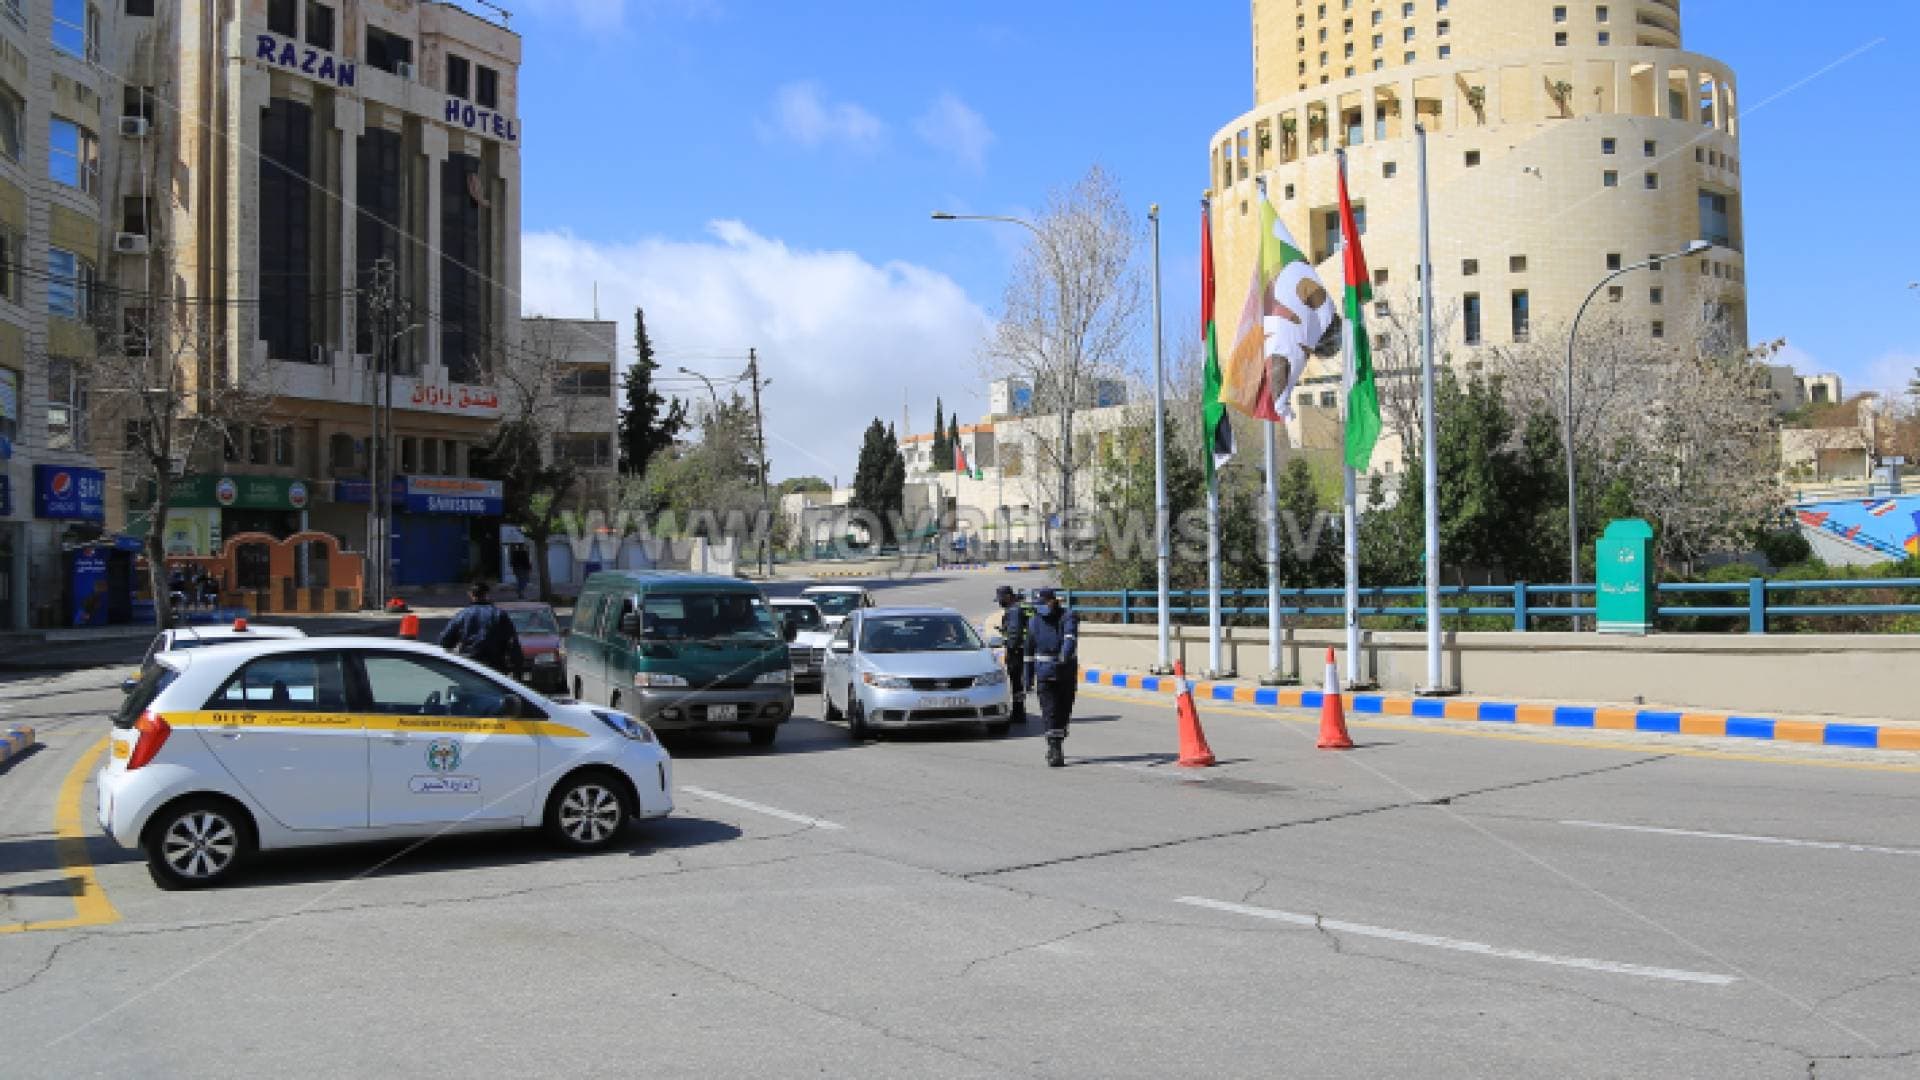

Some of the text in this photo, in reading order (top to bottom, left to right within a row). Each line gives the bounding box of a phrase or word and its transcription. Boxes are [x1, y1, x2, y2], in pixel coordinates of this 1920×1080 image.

[256, 34, 356, 87] RAZAN
[445, 99, 517, 141] HOTEL
[459, 388, 498, 409] فندق
[427, 496, 488, 512] SAMSUNG
[212, 712, 236, 723] 911
